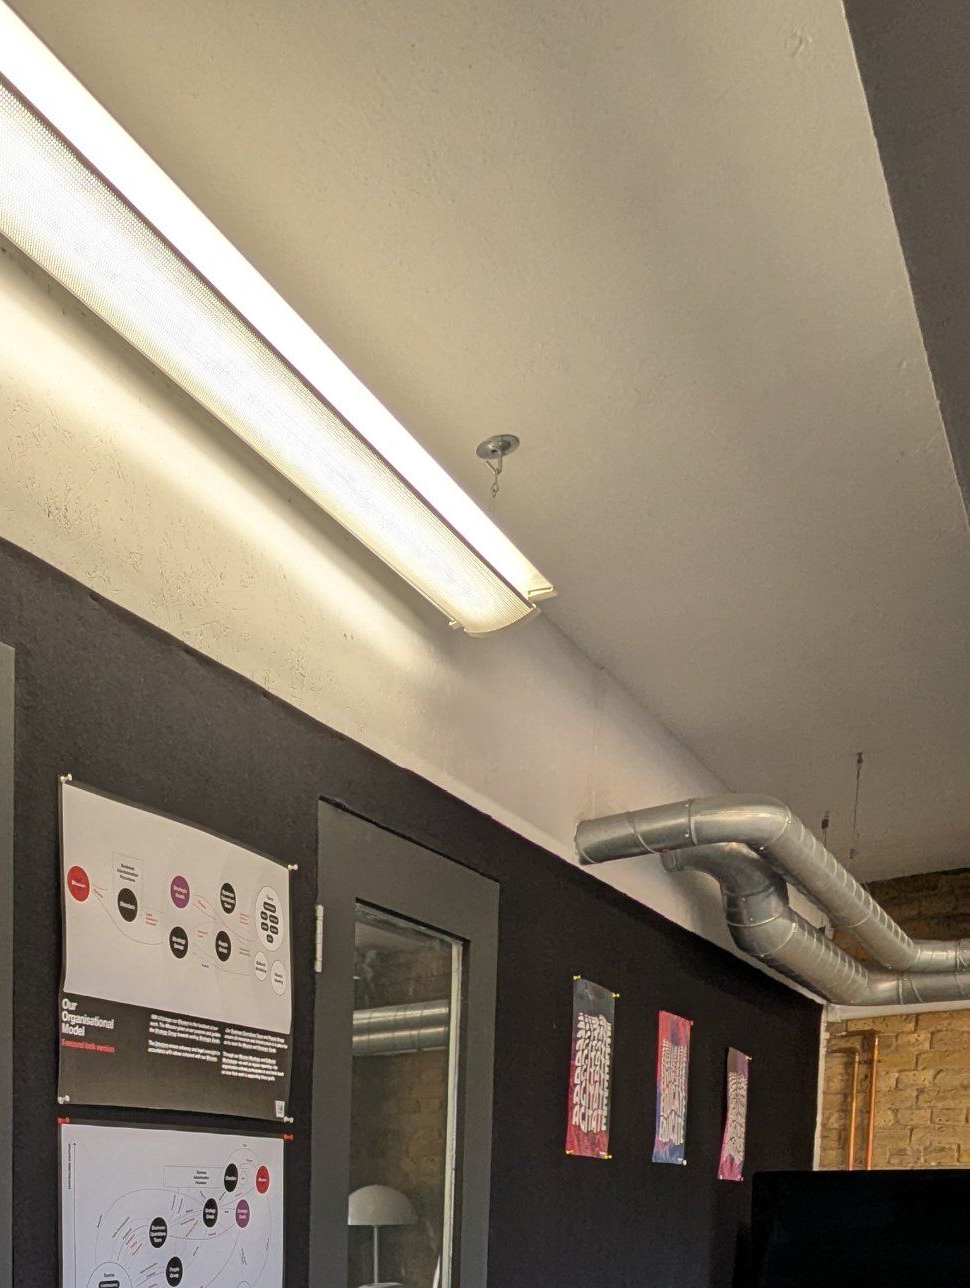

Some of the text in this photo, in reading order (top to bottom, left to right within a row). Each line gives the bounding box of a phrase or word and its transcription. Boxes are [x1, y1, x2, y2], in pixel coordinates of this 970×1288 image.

[61, 998, 78, 1011] Our
[61, 1010, 115, 1030] Organisational
[61, 1022, 85, 1036] Model
[572, 1104, 608, 1134] AGITATE
